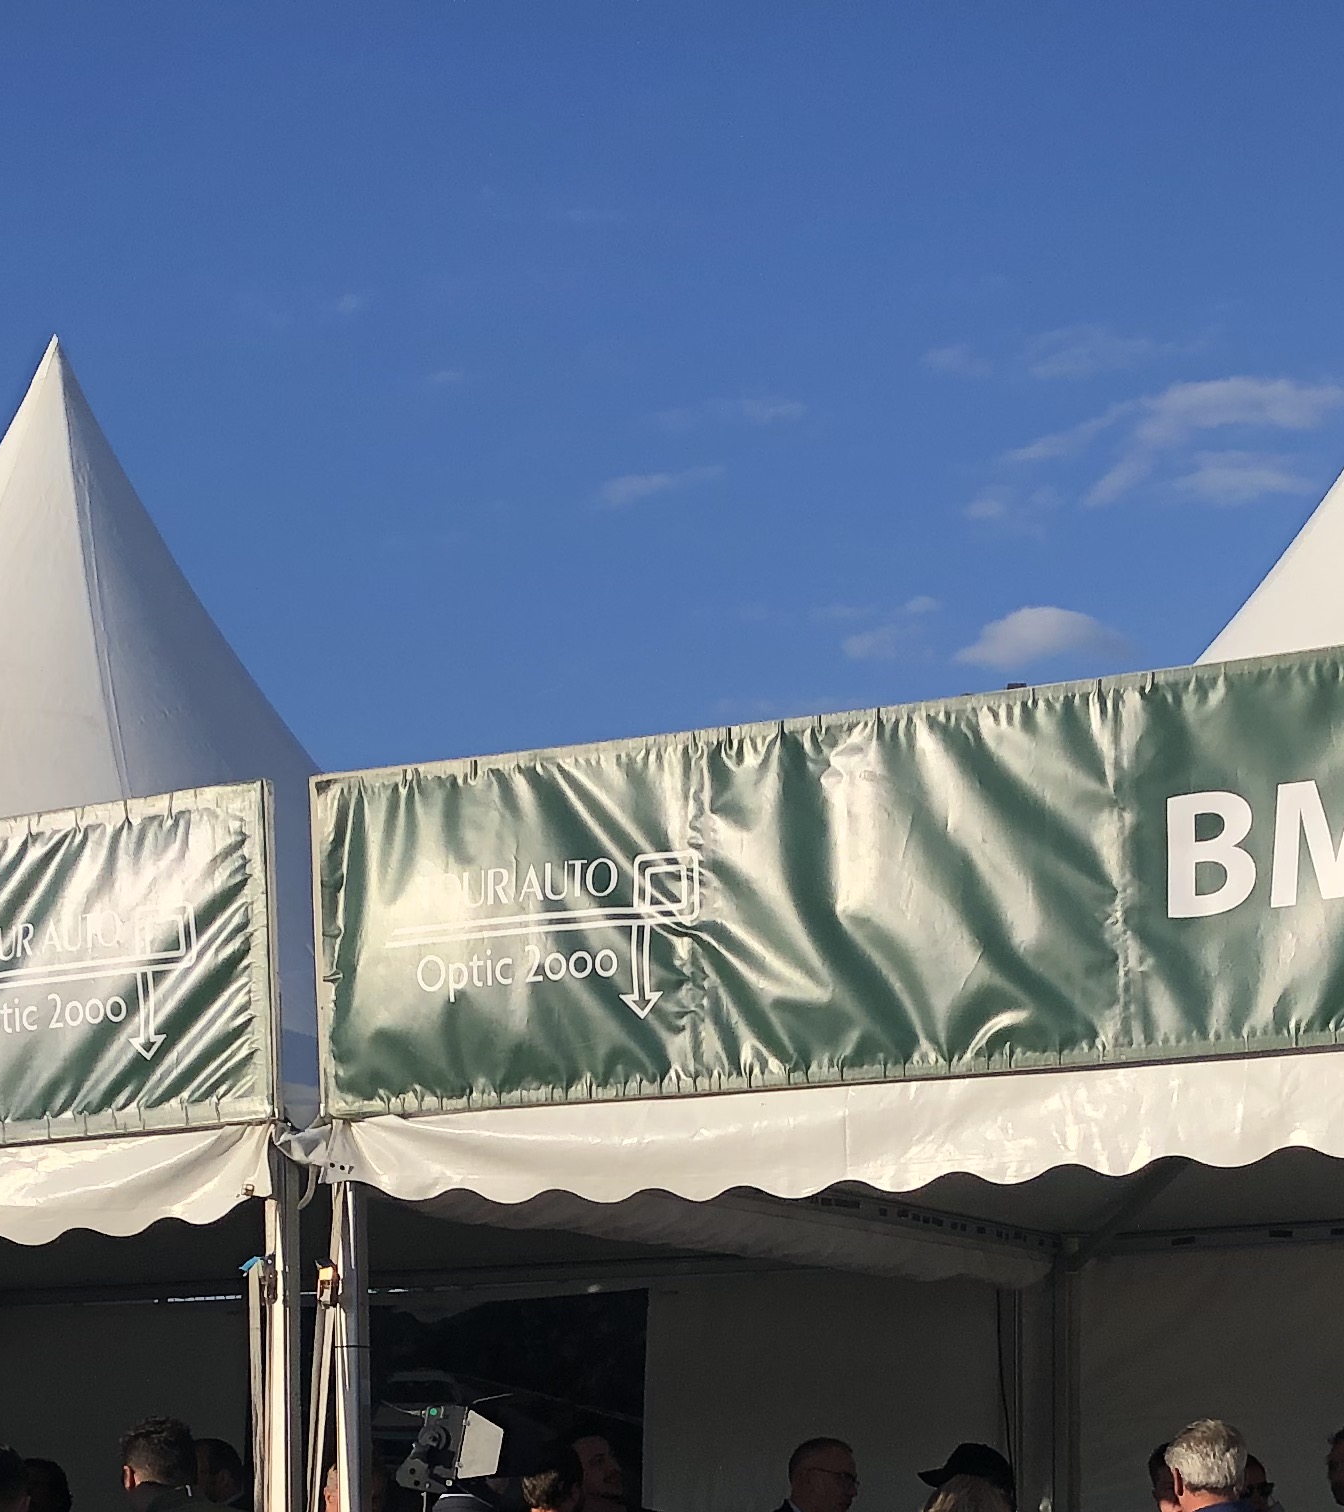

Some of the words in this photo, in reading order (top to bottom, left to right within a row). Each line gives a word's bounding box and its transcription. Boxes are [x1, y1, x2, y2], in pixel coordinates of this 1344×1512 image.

[519, 857, 618, 903] AUTO
[43, 910, 120, 954] AUTO
[417, 949, 512, 1003] Optic
[525, 944, 618, 983] 2000
[47, 993, 127, 1030] 2000
